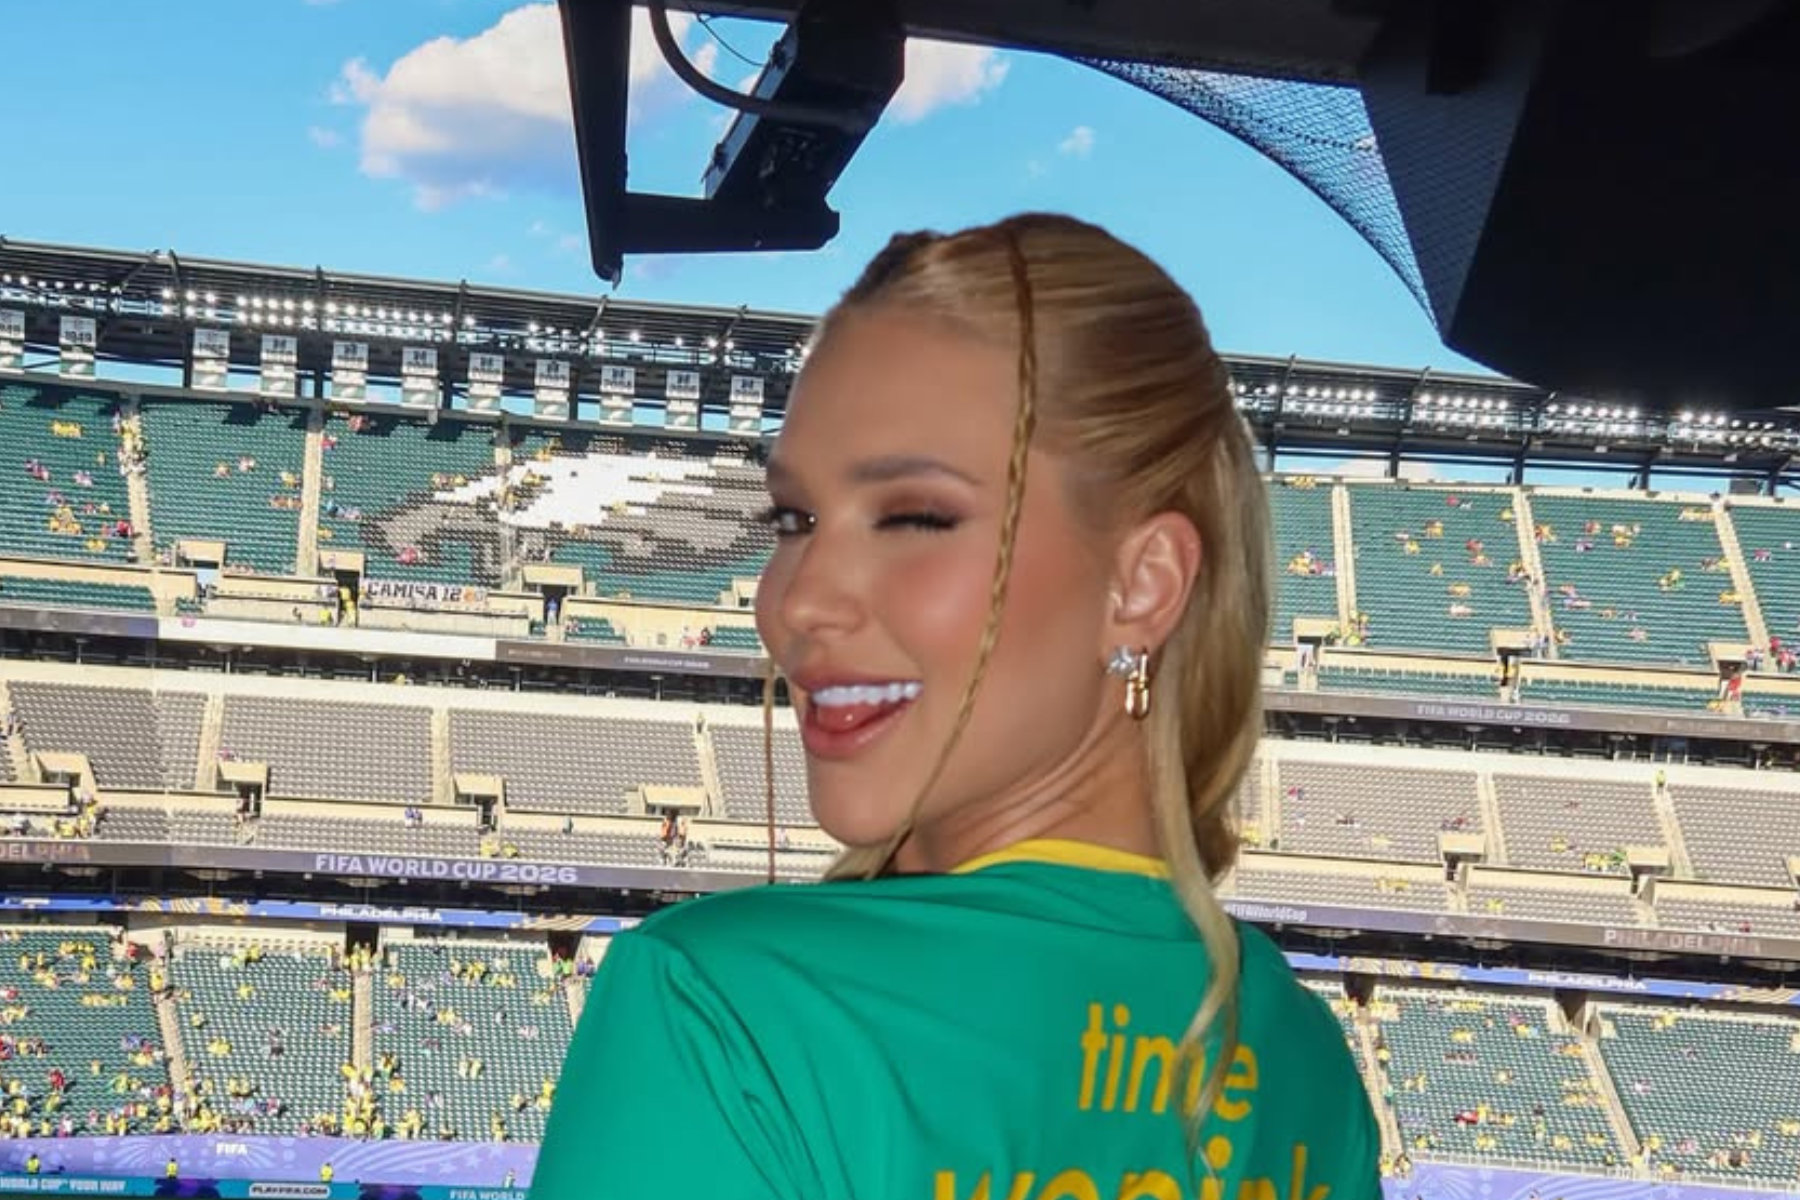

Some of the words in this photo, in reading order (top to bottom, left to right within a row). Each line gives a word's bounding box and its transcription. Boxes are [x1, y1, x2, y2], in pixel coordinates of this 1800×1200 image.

[367, 581, 438, 600] CAMISA
[442, 587, 462, 602] 12
[1417, 704, 1444, 716] FIFA
[1497, 708, 1522, 721] CUP
[316, 854, 366, 873] FIFA
[368, 857, 448, 877] WORLD
[452, 861, 496, 879] CUP
[502, 864, 578, 883] 2026
[320, 906, 443, 922] PHILADELPHIA
[1605, 929, 1761, 955] PHILADELPHIA
[1529, 972, 1647, 989] PHILADELPHIA
[1078, 1003, 1258, 1121] time
[216, 1143, 247, 1156] FIFA
[450, 1190, 477, 1200] FIFA
